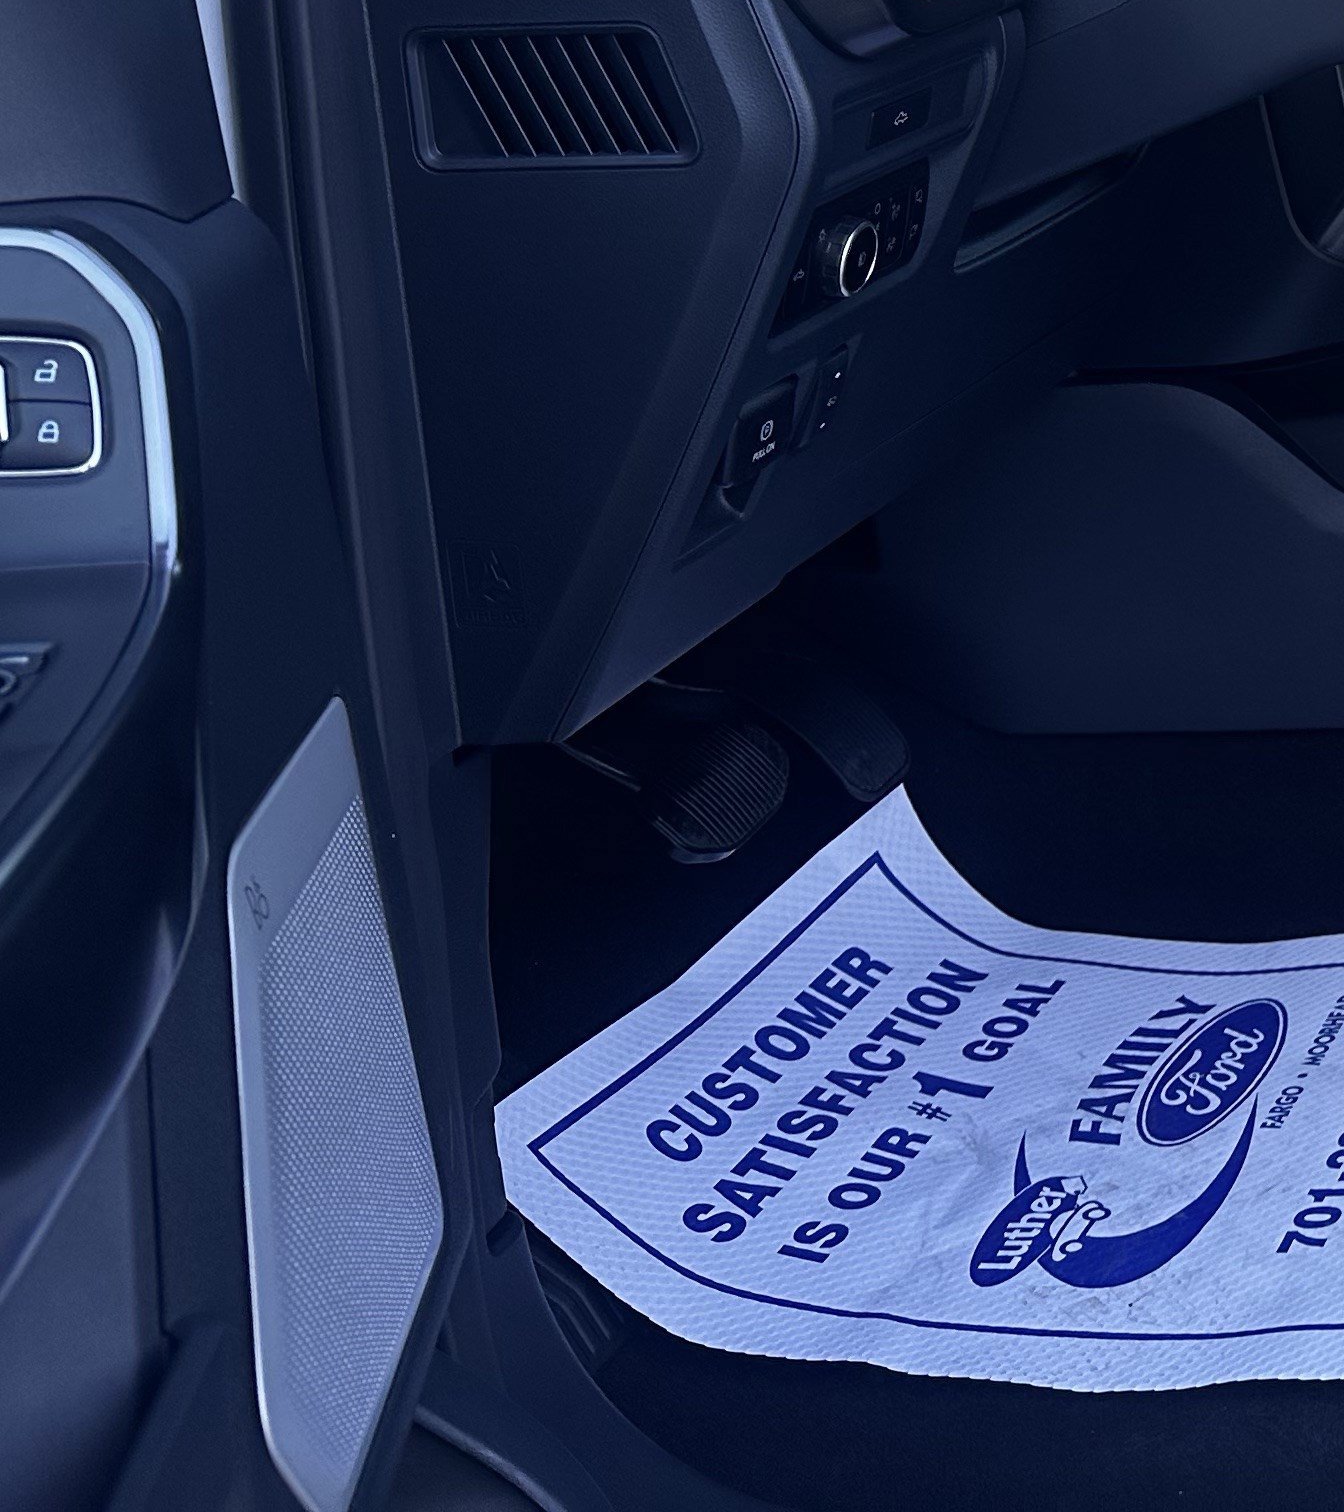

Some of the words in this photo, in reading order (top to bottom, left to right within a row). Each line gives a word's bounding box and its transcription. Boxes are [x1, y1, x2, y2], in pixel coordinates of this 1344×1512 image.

[646, 946, 895, 1162] CUSTOMER
[682, 958, 990, 1243] SATISFACTION
[777, 1220, 849, 1264] IS
[827, 1126, 933, 1210] OUR
[907, 1071, 995, 1122] #1
[962, 978, 1067, 1062] GOAL
[1068, 994, 1217, 1146] FAMILY
[1160, 1027, 1266, 1115] Ford
[1259, 1085, 1305, 1129] FARGO
[977, 1185, 1067, 1271] Luther
